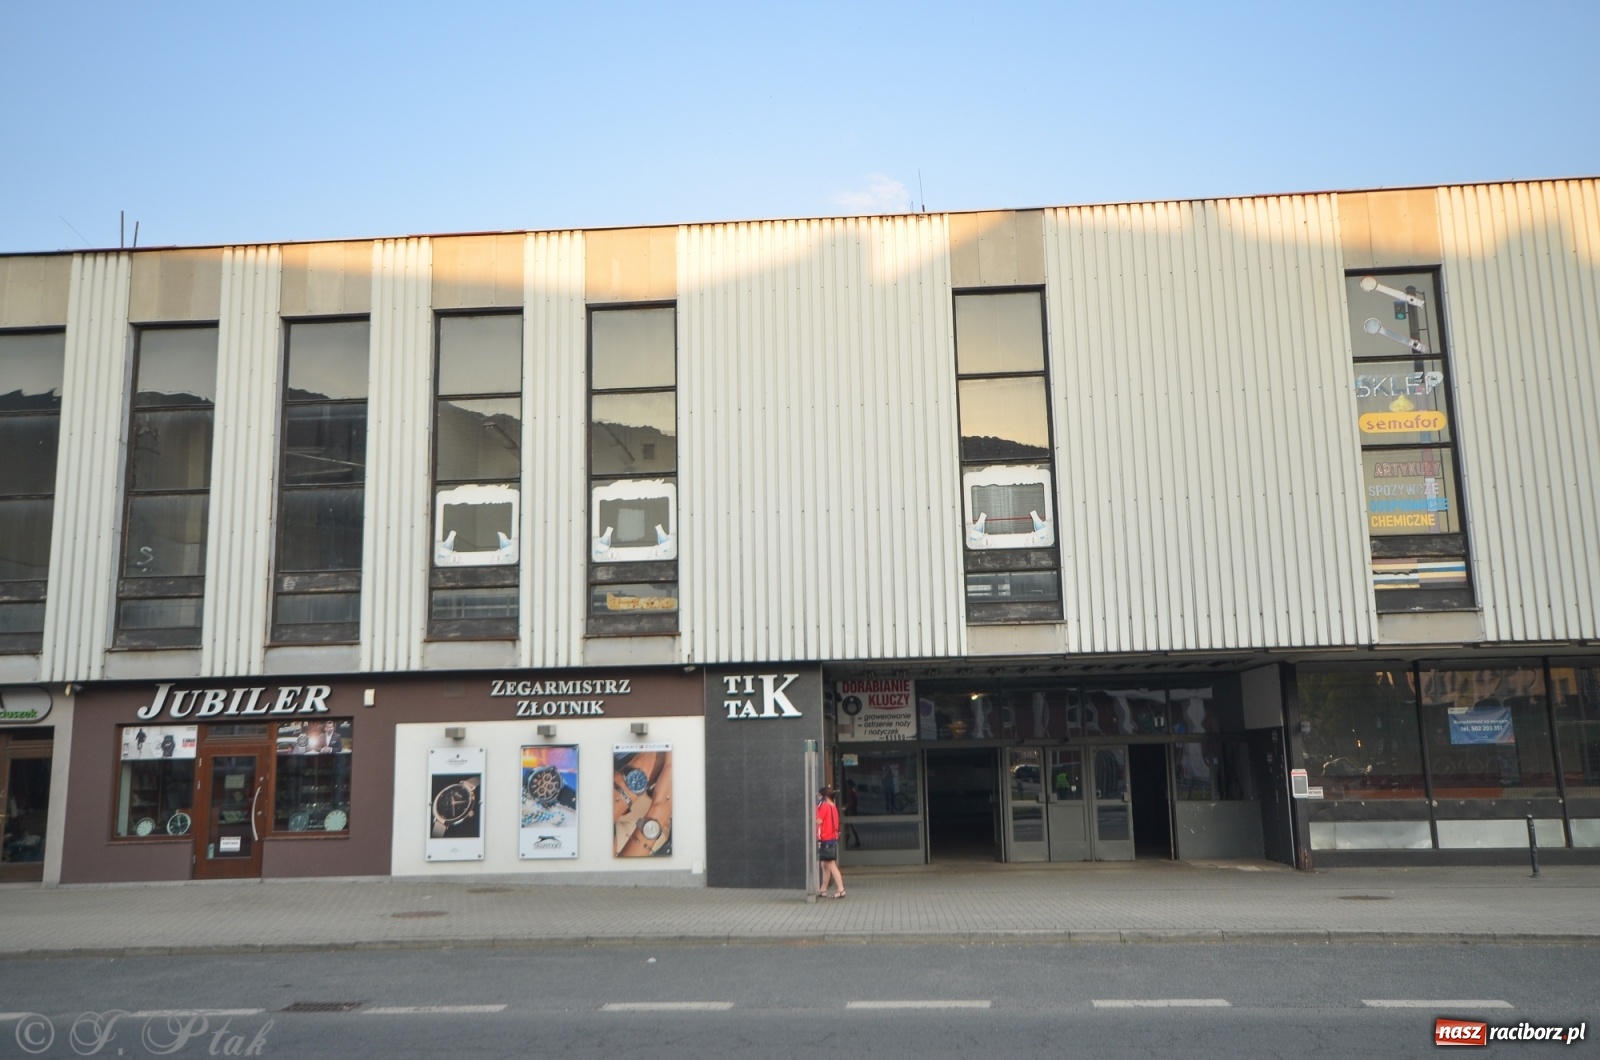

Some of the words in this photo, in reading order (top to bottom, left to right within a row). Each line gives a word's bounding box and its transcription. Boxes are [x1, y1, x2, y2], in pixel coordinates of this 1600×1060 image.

[1356, 371, 1444, 398] SKLEP
[1366, 414, 1438, 430] semafor
[1371, 513, 1436, 527] CHEMICZNE
[490, 679, 631, 698] ZEGARMISTRZ
[842, 679, 910, 694] DORABIANIE
[137, 683, 332, 720] JUBILER
[868, 693, 910, 706] KLUCZY
[515, 699, 605, 717] ZŁOTNIK
[863, 712, 911, 722] grawerowanie
